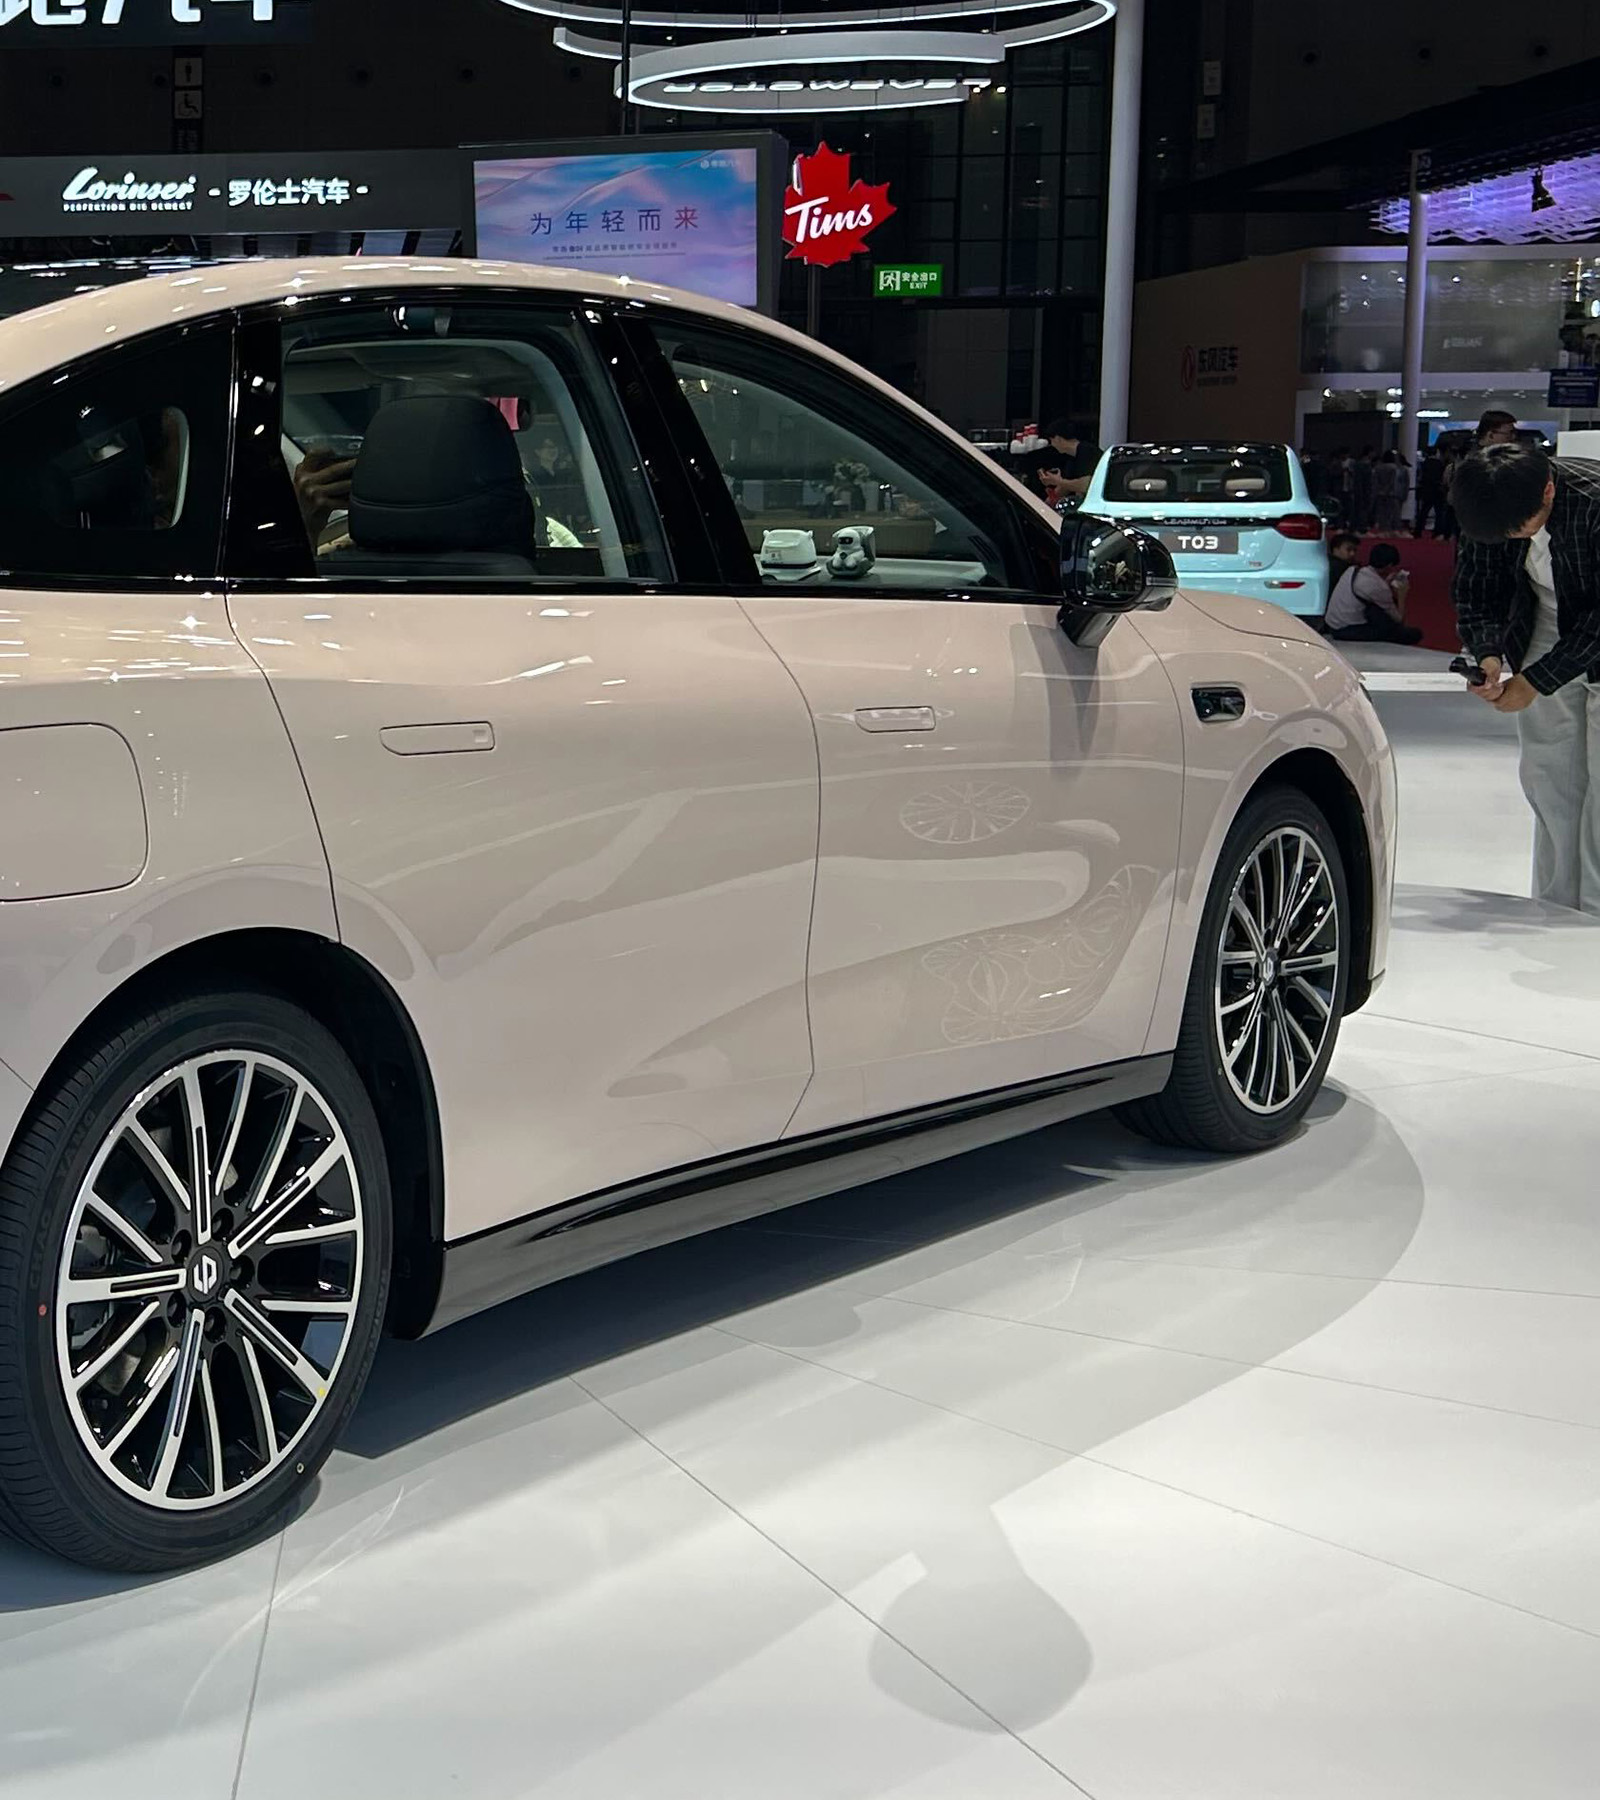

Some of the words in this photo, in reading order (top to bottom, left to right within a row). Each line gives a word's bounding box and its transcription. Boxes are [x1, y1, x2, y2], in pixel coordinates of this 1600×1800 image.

[62, 167, 196, 201] Lorinser
[228, 178, 350, 206] 罗伦士汽车
[530, 206, 699, 235] 为年轻而来
[785, 196, 873, 243] Tims
[901, 272, 937, 282] 安全出口
[1177, 535, 1219, 550] T03
